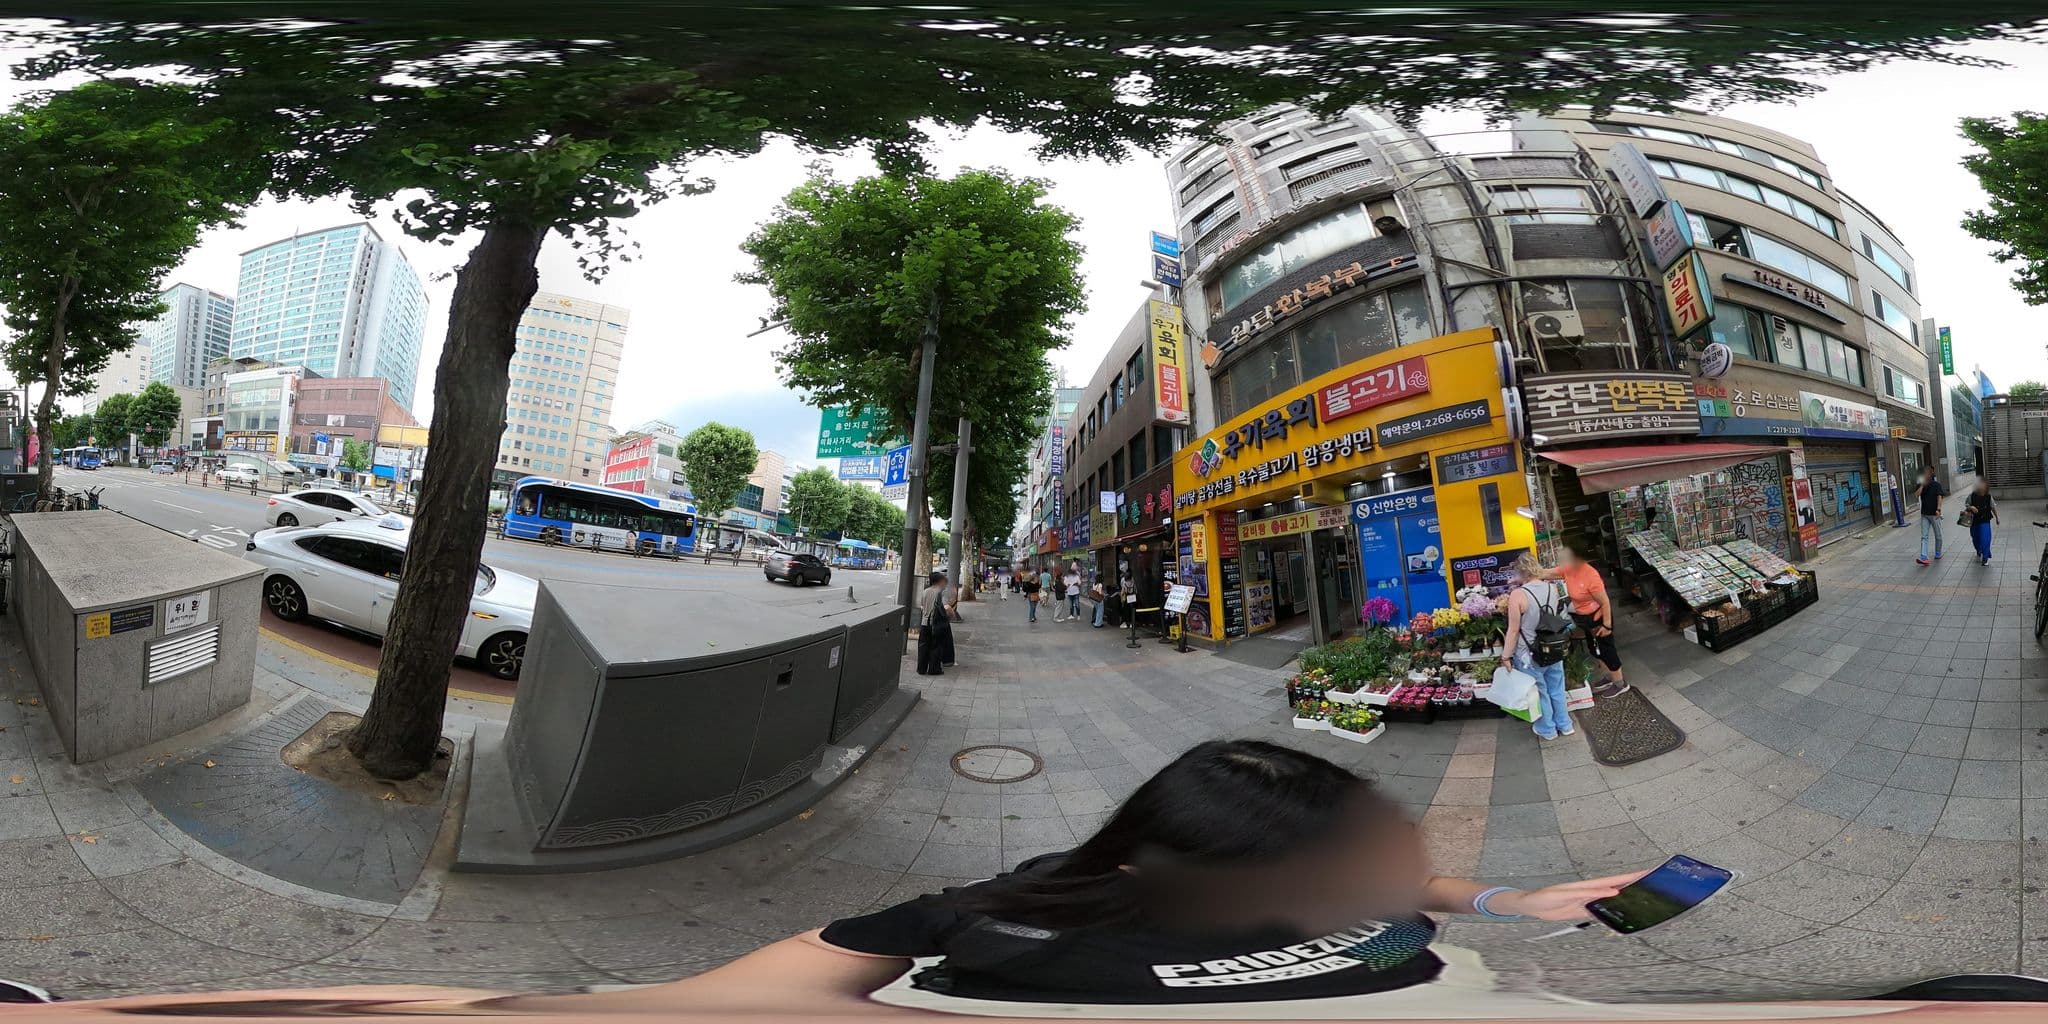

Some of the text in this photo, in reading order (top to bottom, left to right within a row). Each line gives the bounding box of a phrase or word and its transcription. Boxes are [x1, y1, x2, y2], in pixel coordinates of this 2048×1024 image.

[1275, 261, 1368, 317] 한복부
[1671, 271, 1698, 328] 의료기
[1159, 331, 1177, 365] 육회
[1161, 365, 1181, 405] 불고기
[1326, 364, 1406, 416] 불고기
[1535, 379, 1688, 417] 주단 한복부
[1223, 393, 1318, 459] 우기육회
[1568, 415, 1673, 433] 대동/신대동 출입구
[1175, 427, 1373, 509] 갈비탕 곱창전골 육수불고기 함흥냉면
[1372, 495, 1418, 515] 신한은행
[1152, 918, 1393, 979] PRIDEZILLA
